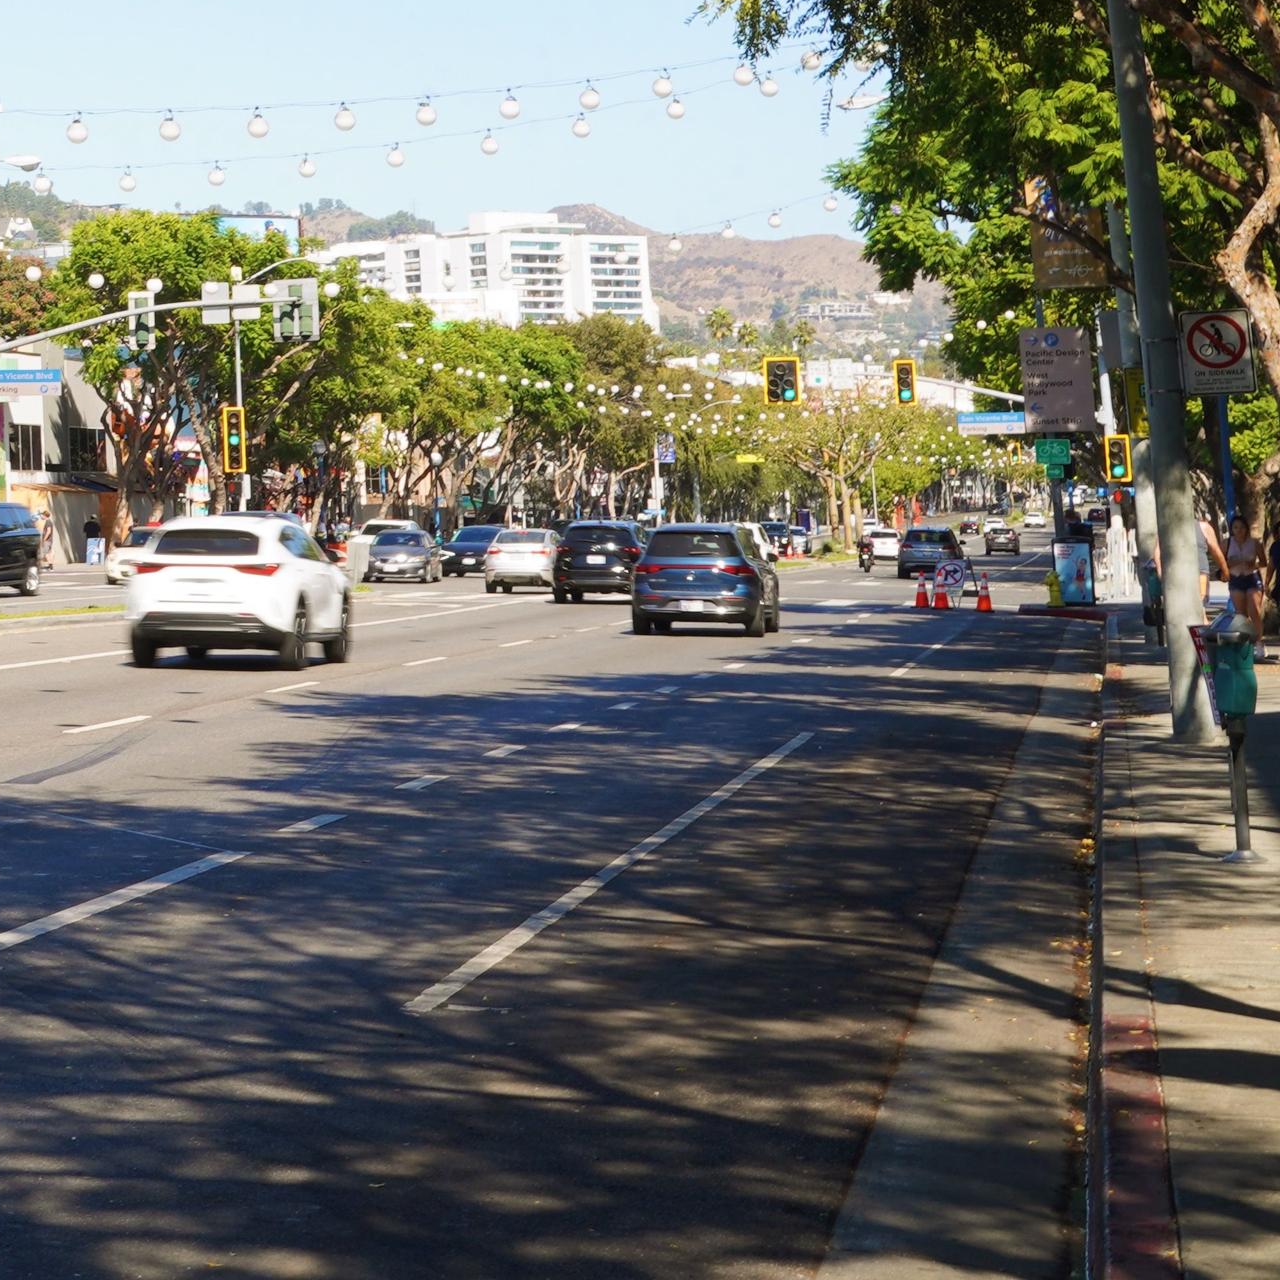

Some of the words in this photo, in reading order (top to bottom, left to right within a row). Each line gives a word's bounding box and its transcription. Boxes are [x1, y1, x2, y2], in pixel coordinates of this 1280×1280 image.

[1025, 349, 1054, 357] Pacific
[1055, 349, 1085, 359] Design
[5, 372, 34, 380] Vicente
[36, 372, 54, 380] Blvd
[1208, 368, 1246, 376] SIDEWALK
[1027, 380, 1073, 388] Hollywood
[1032, 417, 1059, 425] Sunset
[1061, 416, 1082, 426] Strip
